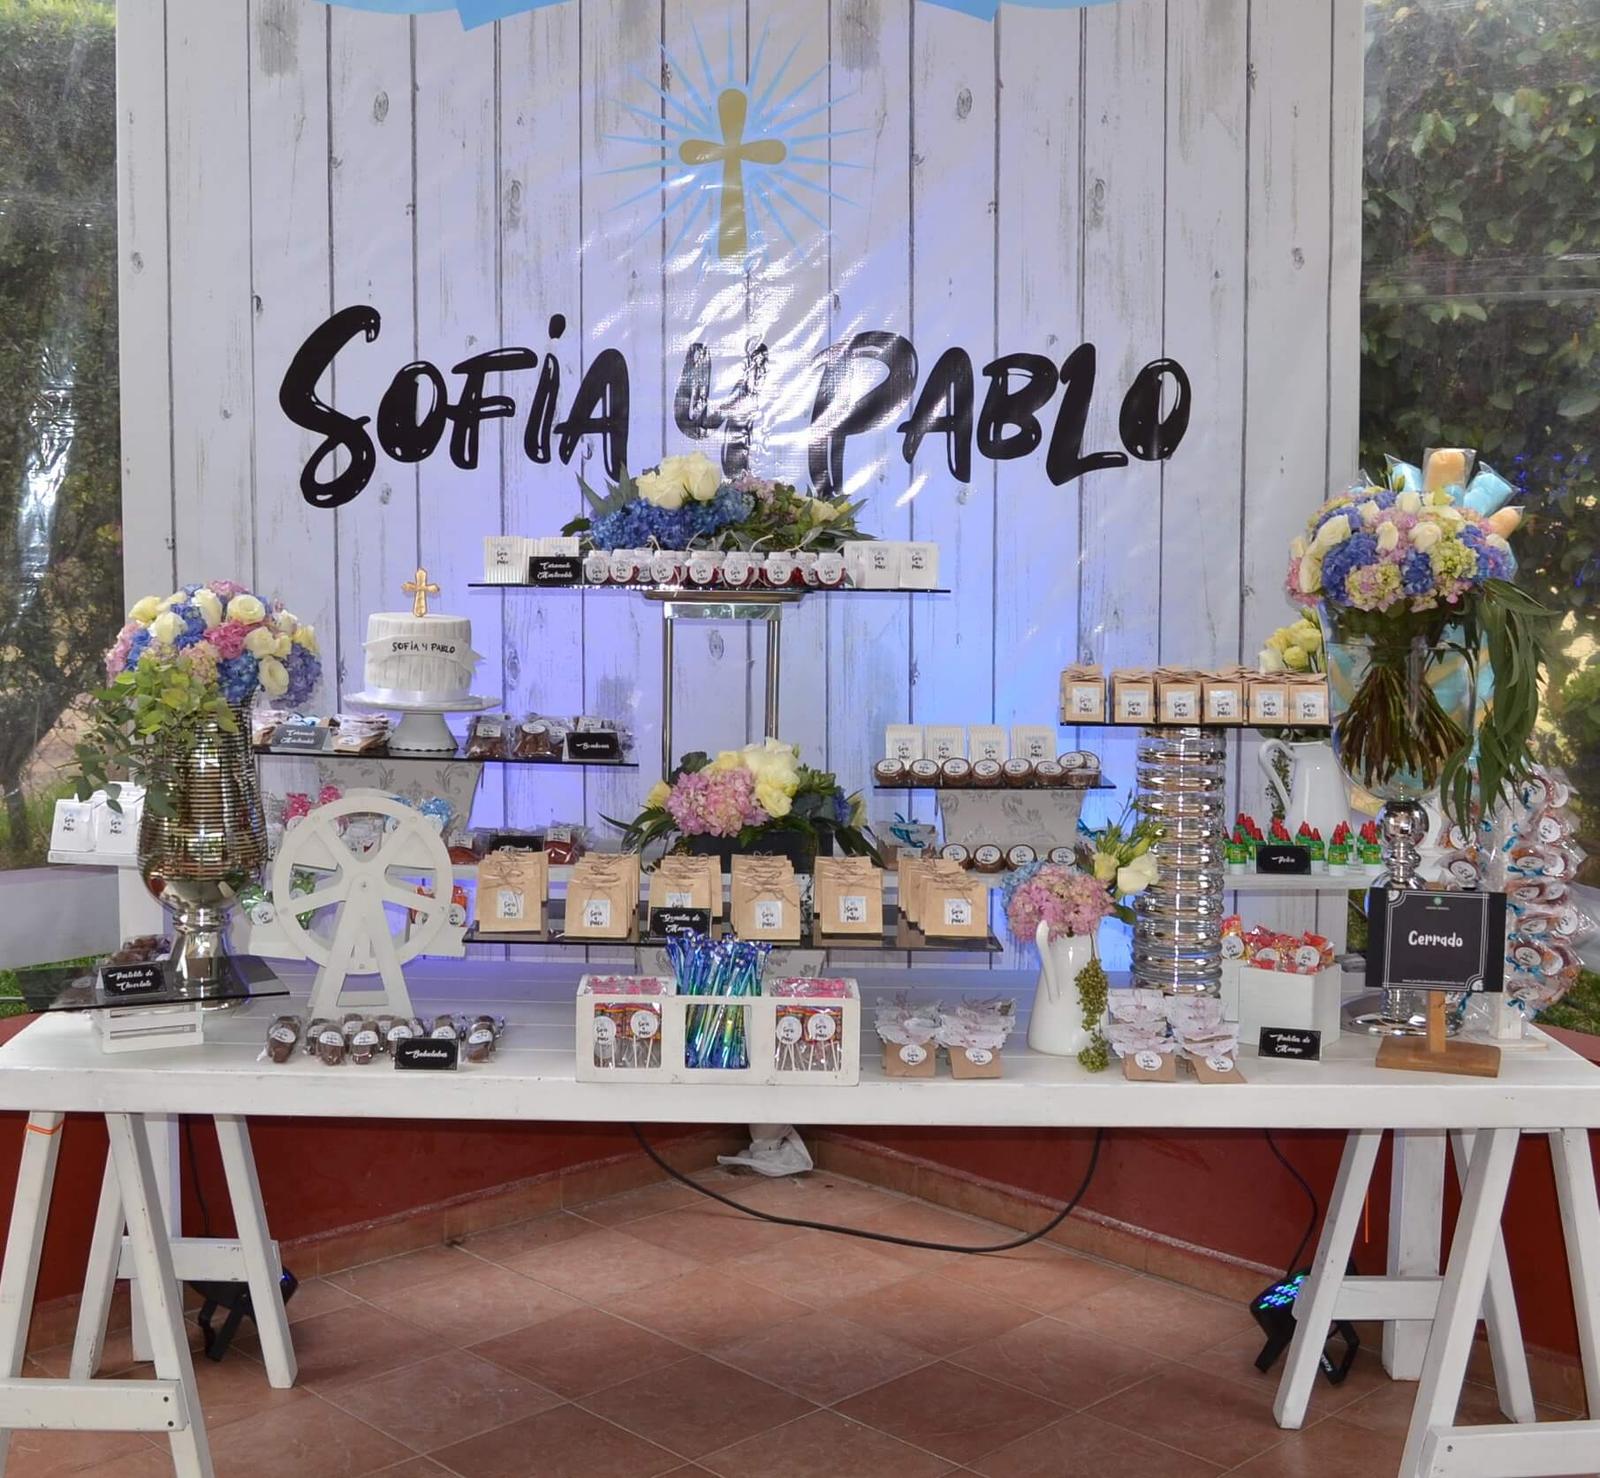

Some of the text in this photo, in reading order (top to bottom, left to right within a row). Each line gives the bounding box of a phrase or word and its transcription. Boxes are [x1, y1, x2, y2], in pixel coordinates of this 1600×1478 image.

[808, 330, 1192, 496] PABLO
[431, 643, 456, 654] PABLO
[1408, 930, 1464, 948] Cerrado
